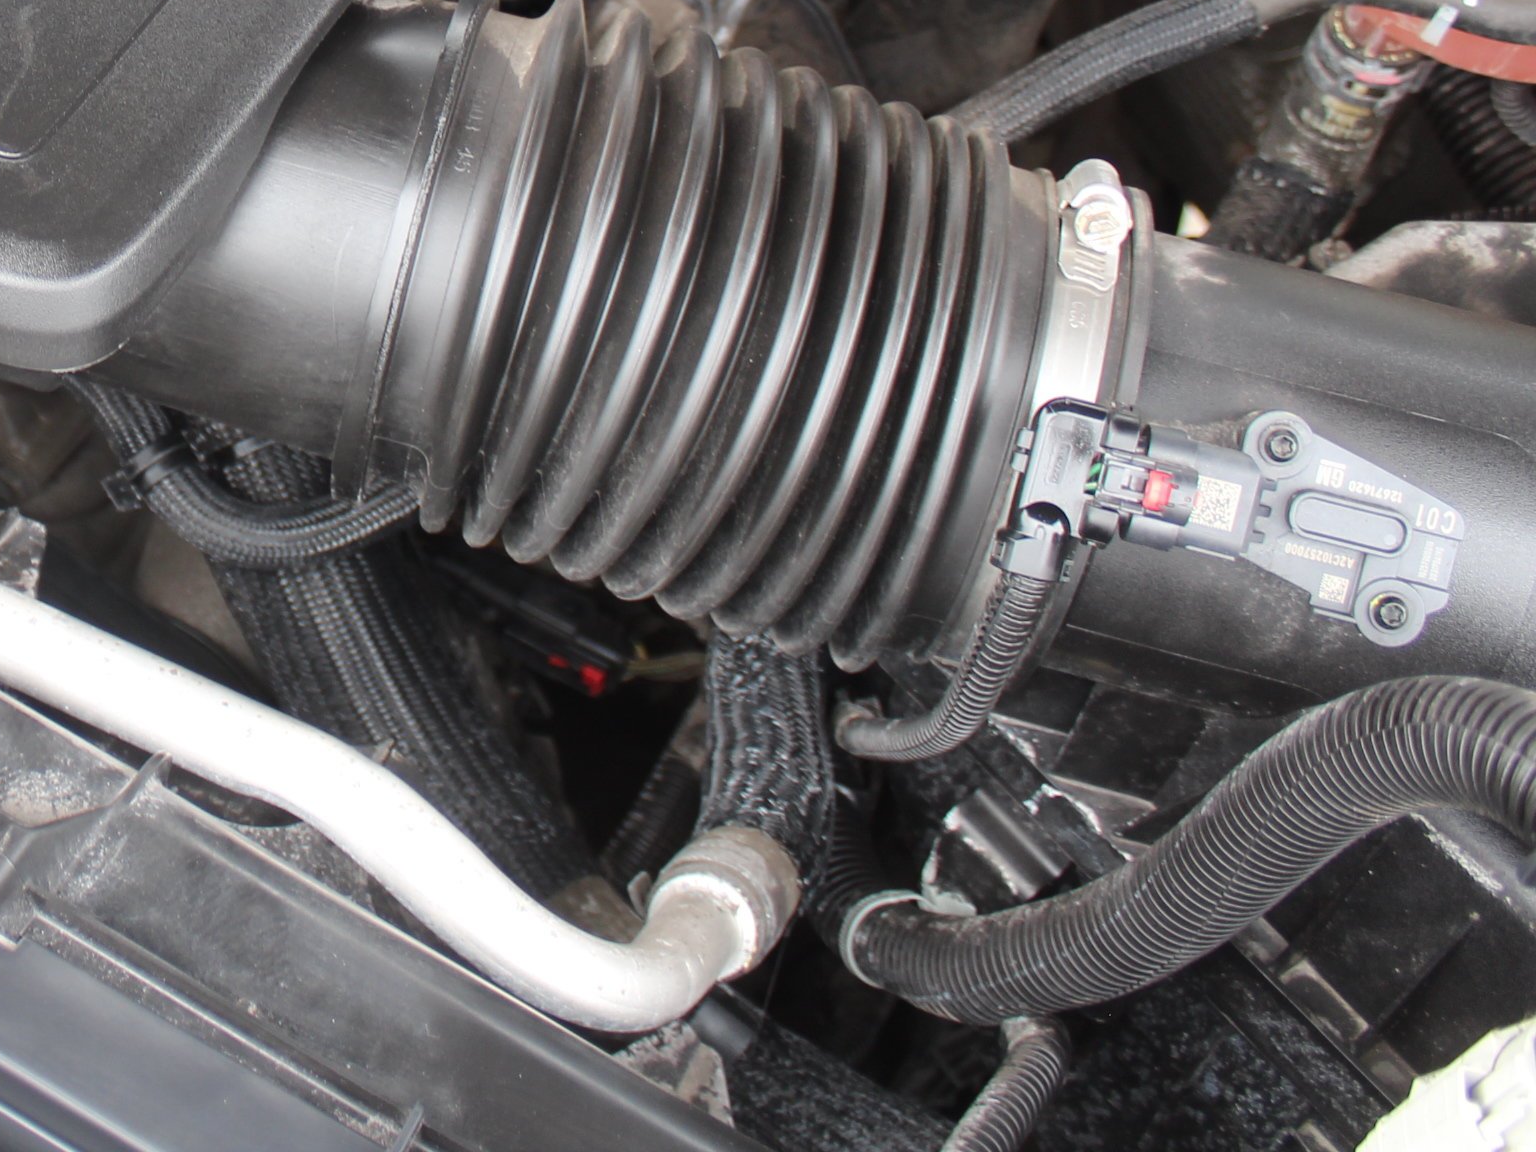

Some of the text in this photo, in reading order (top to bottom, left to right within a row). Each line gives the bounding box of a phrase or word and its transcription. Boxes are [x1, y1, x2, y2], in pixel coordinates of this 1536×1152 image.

[1315, 460, 1403, 503] 12671620 GM
[1415, 504, 1456, 534] C01
